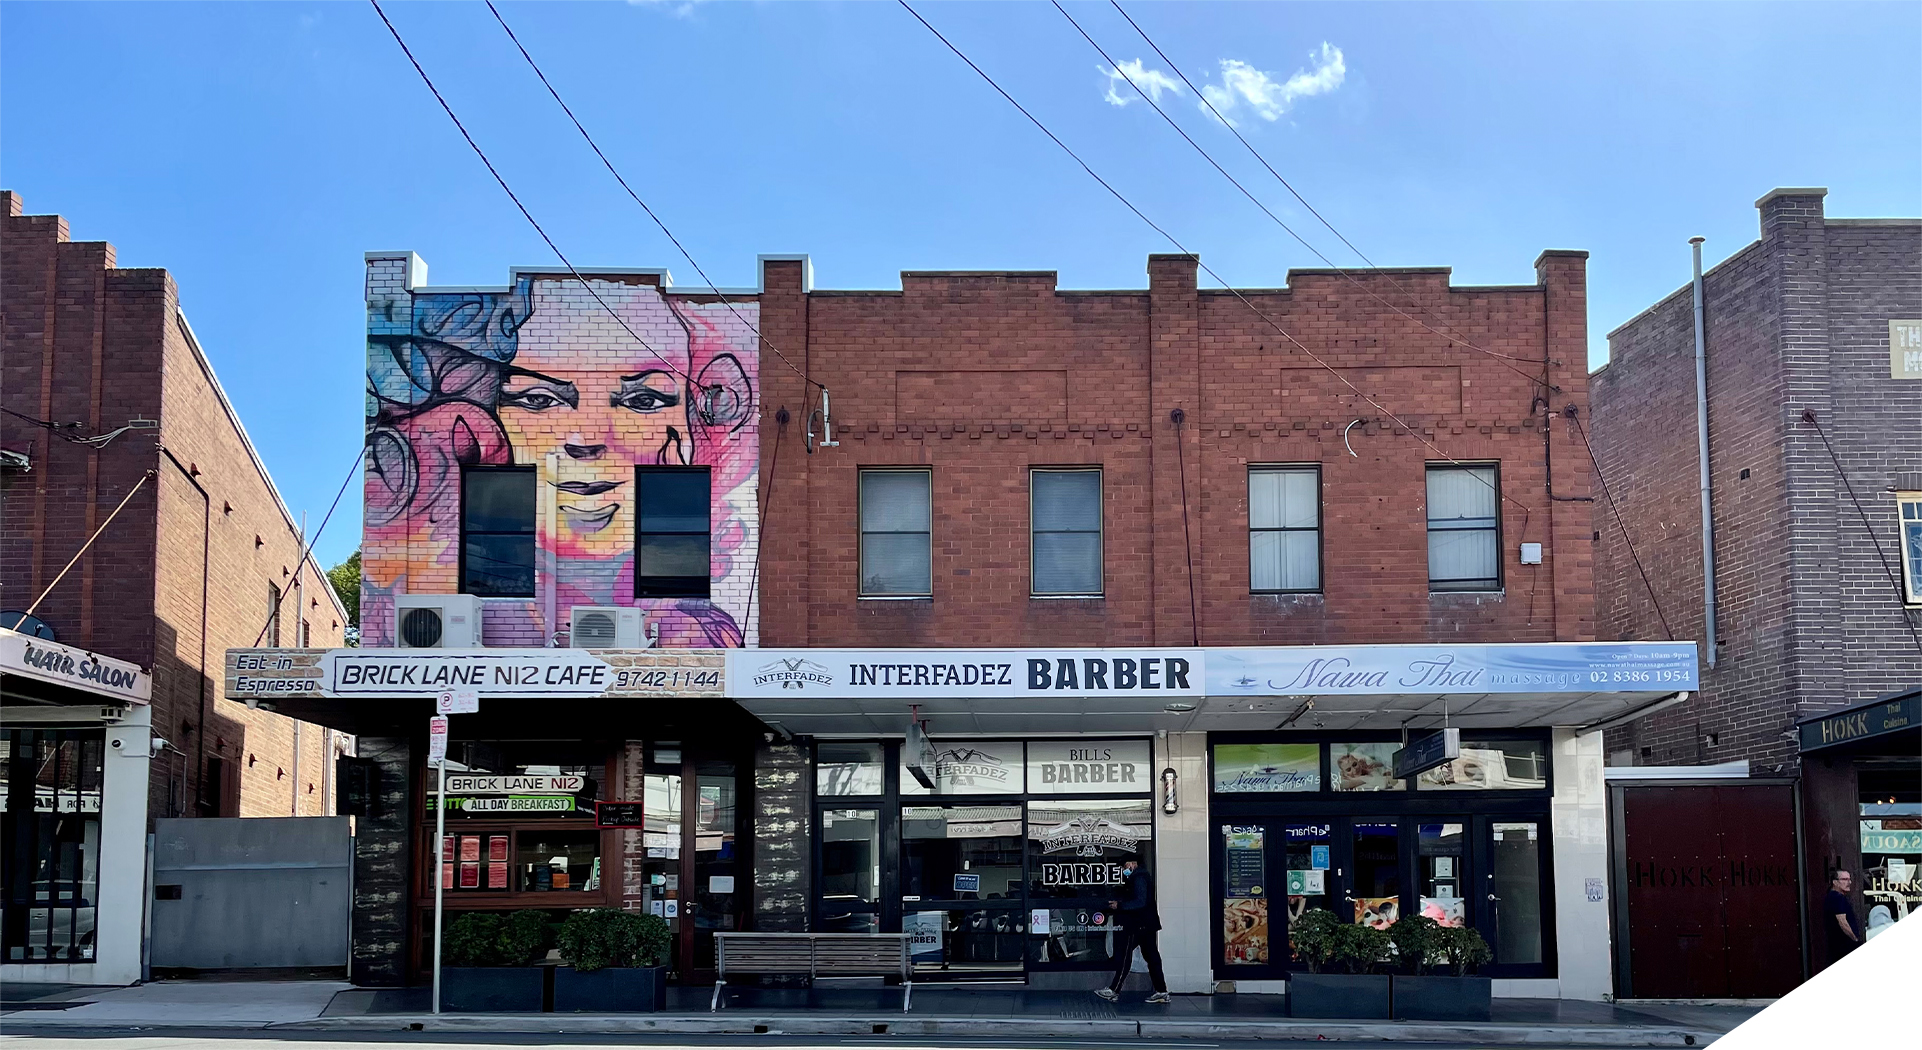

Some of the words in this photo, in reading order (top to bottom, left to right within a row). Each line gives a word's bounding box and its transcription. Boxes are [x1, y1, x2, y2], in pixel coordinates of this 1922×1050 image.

[1904, 351, 1922, 372] M
[1650, 652, 1690, 660] 10am-9pm
[23, 647, 75, 676] HAIR
[78, 660, 137, 689] SALON
[341, 665, 418, 685] BRICK
[421, 665, 486, 685] LANE
[544, 665, 606, 685] CAFE
[849, 664, 1012, 686] INTERFADEZ
[1026, 657, 1191, 689] BARBER
[1267, 657, 1389, 690] Nawa
[1398, 650, 1485, 687] Thai
[1490, 670, 1581, 690] massage
[753, 671, 834, 687] INTERFADEZ
[1590, 671, 1608, 683] 02
[1613, 670, 1650, 682] 8386
[1655, 670, 1691, 682] 1954
[235, 676, 315, 695] Espresso
[1886, 701, 1901, 715] Thai
[1822, 712, 1868, 743] HOKK
[1883, 717, 1908, 729] Cuisine
[1070, 748, 1112, 761] BILLS
[936, 765, 1008, 781] TERFADEZ
[1041, 763, 1136, 783] BARBER
[452, 778, 498, 790] BRICK
[504, 777, 544, 790] LANE
[471, 799, 489, 810] ALL
[491, 799, 509, 810] DAY
[511, 799, 566, 810] BREAKFAST
[848, 810, 856, 818] 10
[1044, 834, 1138, 851] INTERFADEZ
[1635, 862, 1714, 888] HOKK
[910, 936, 937, 944] RBER
